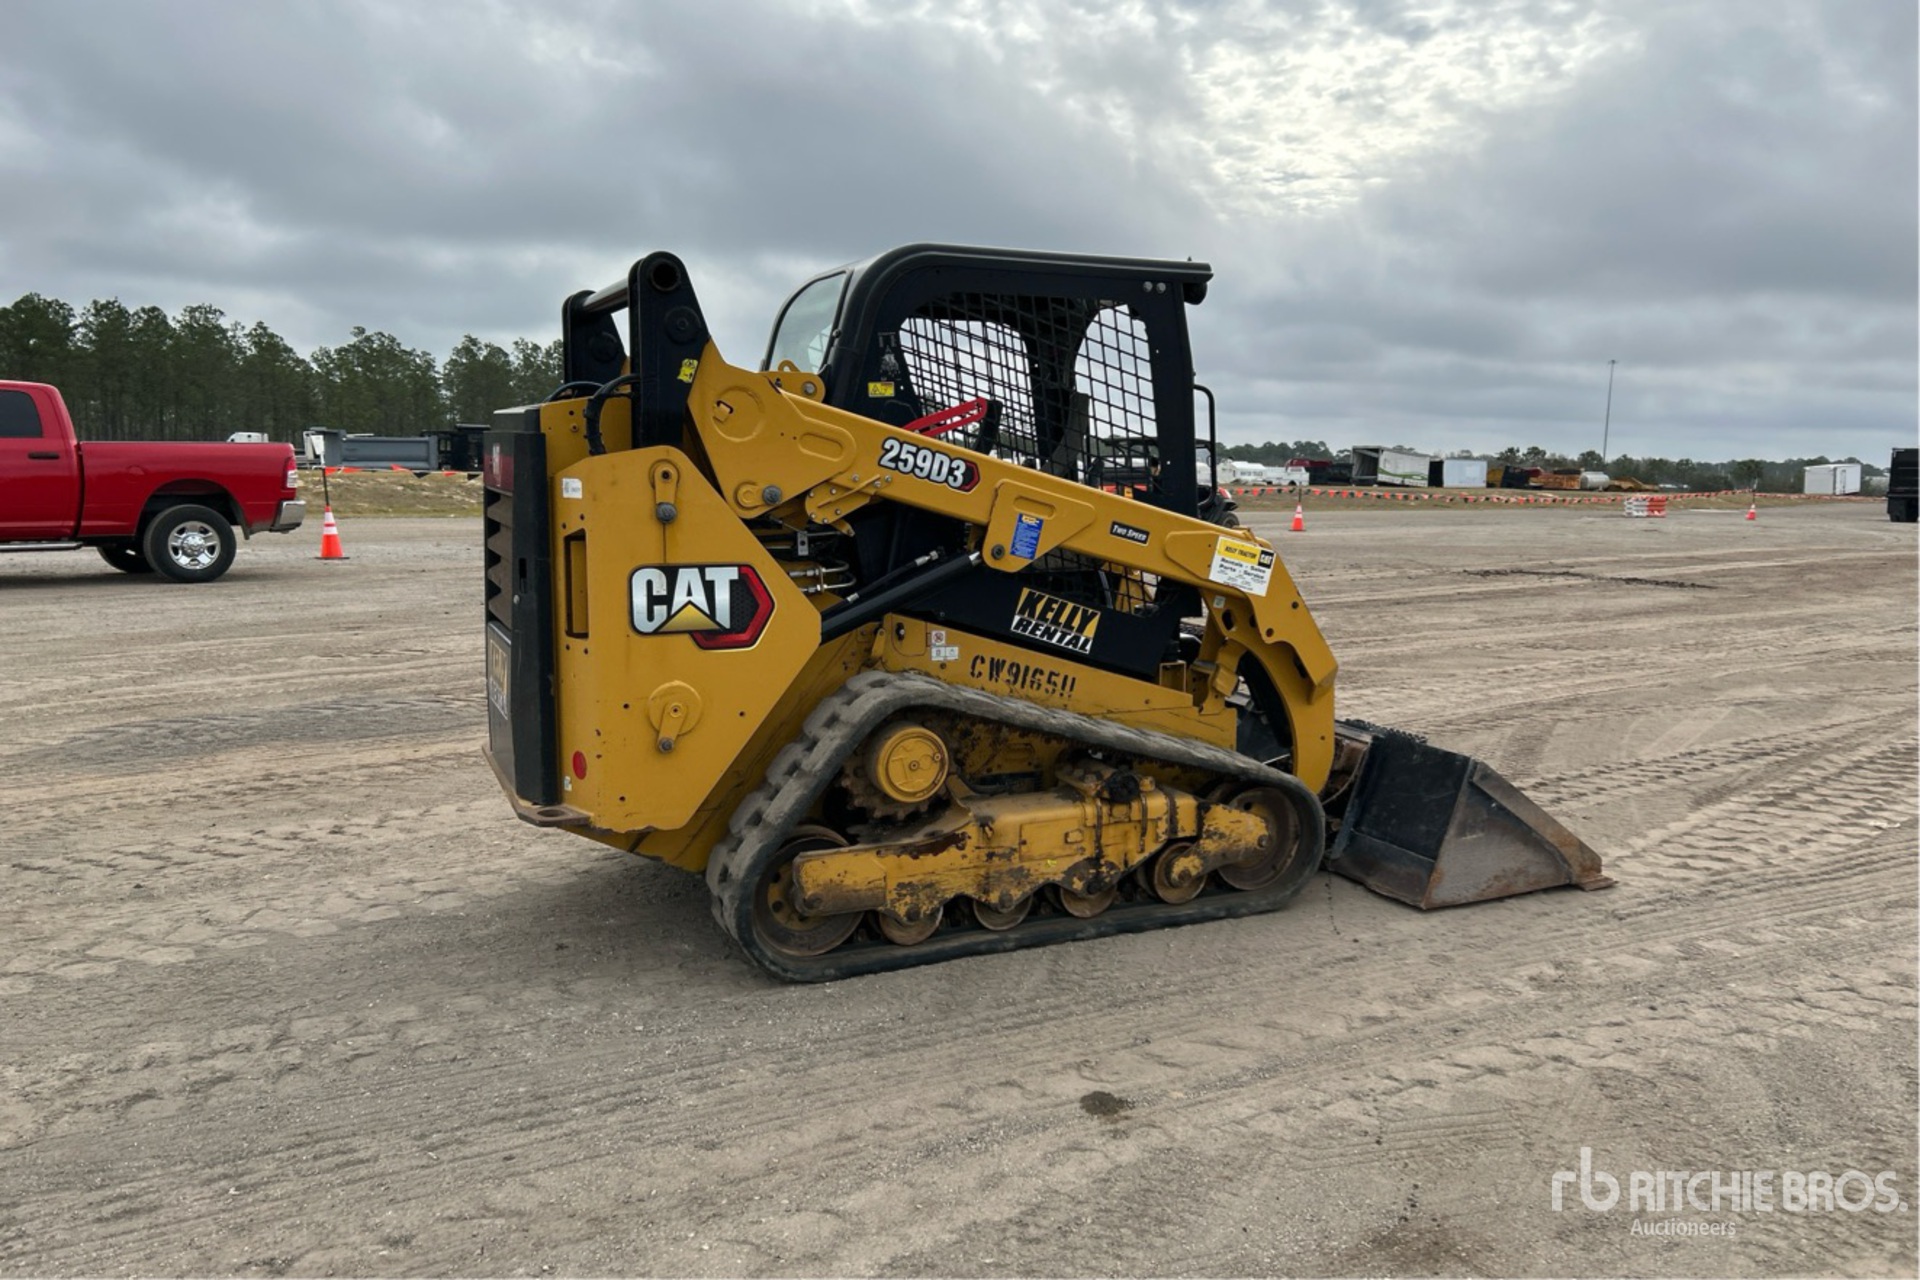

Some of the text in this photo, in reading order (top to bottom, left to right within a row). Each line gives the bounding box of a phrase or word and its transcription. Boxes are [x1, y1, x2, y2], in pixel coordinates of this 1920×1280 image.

[879, 437, 966, 488] 259D3
[631, 566, 739, 633] CAT
[1017, 591, 1098, 635] KELLY
[1013, 619, 1092, 652] RENTAL
